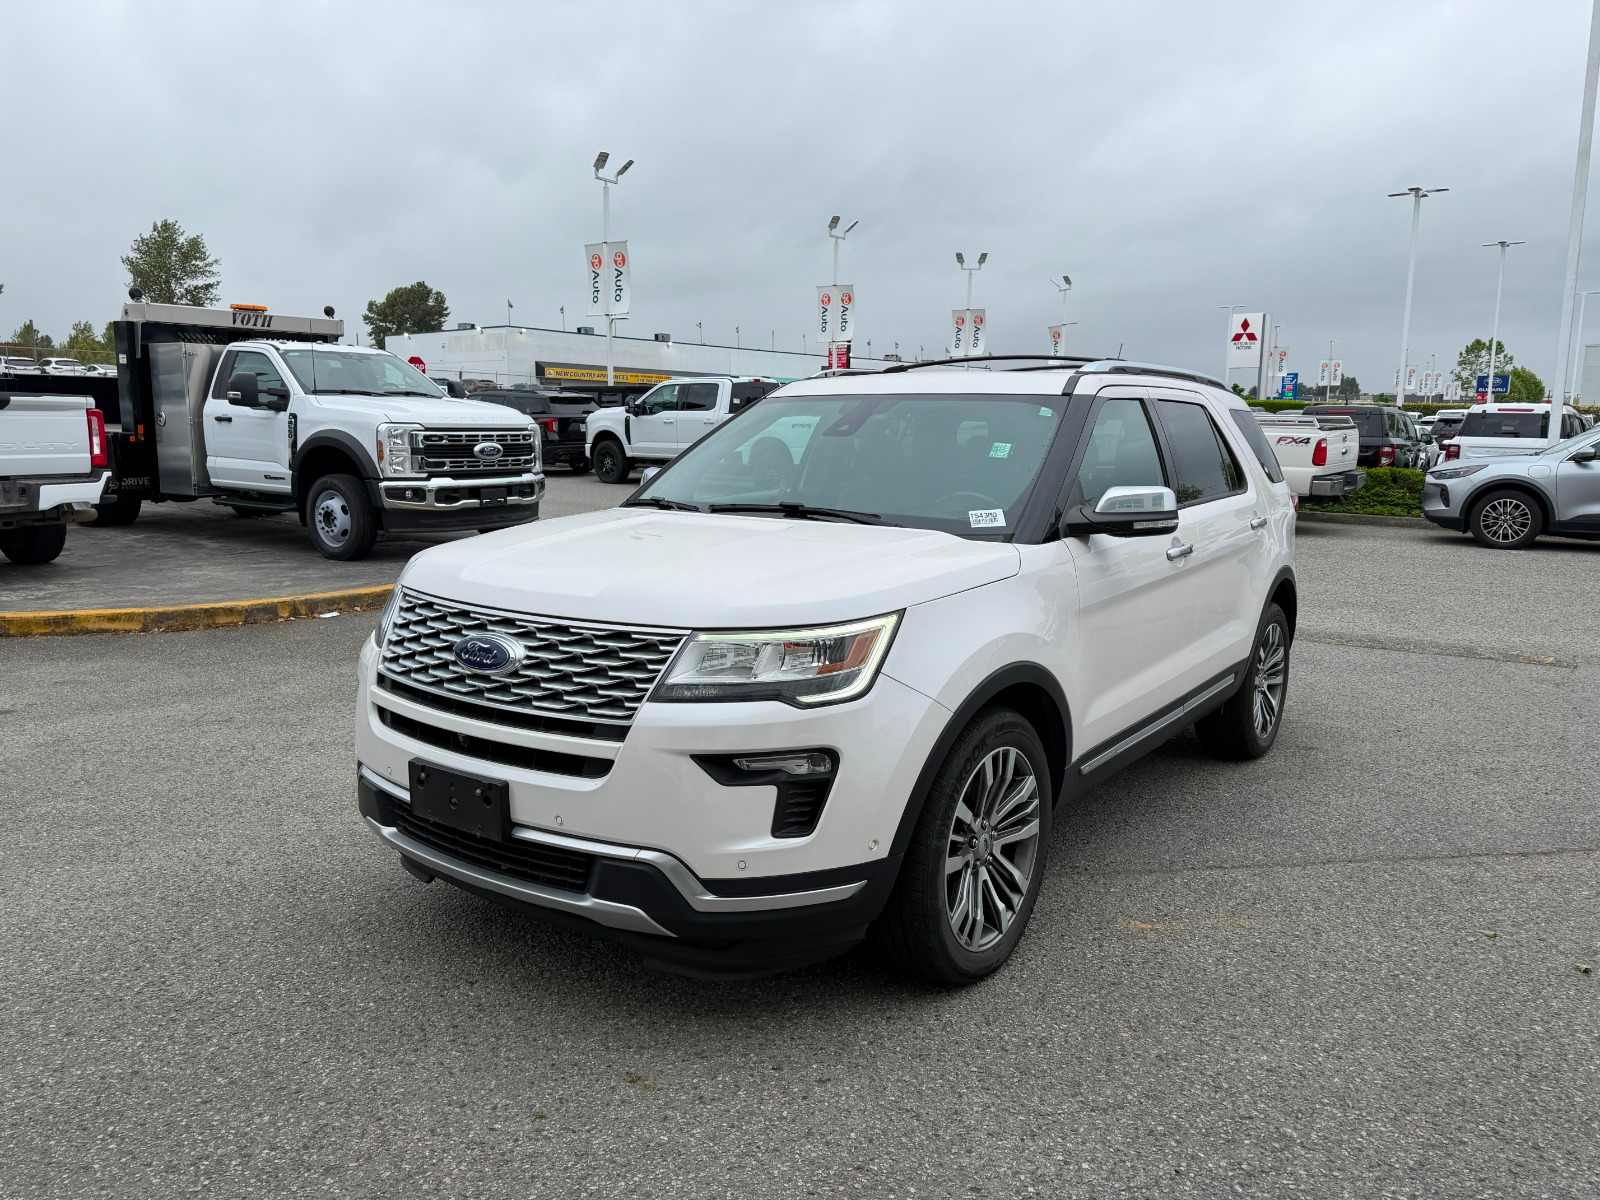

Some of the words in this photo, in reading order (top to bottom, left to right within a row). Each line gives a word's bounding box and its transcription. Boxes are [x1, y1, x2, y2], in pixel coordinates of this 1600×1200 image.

[592, 270, 600, 304] Auto
[614, 268, 624, 302] Auto
[232, 312, 272, 327] VOTH
[841, 305, 849, 332] Auto
[1276, 436, 1311, 445] FX4
[461, 641, 497, 664] Ford
